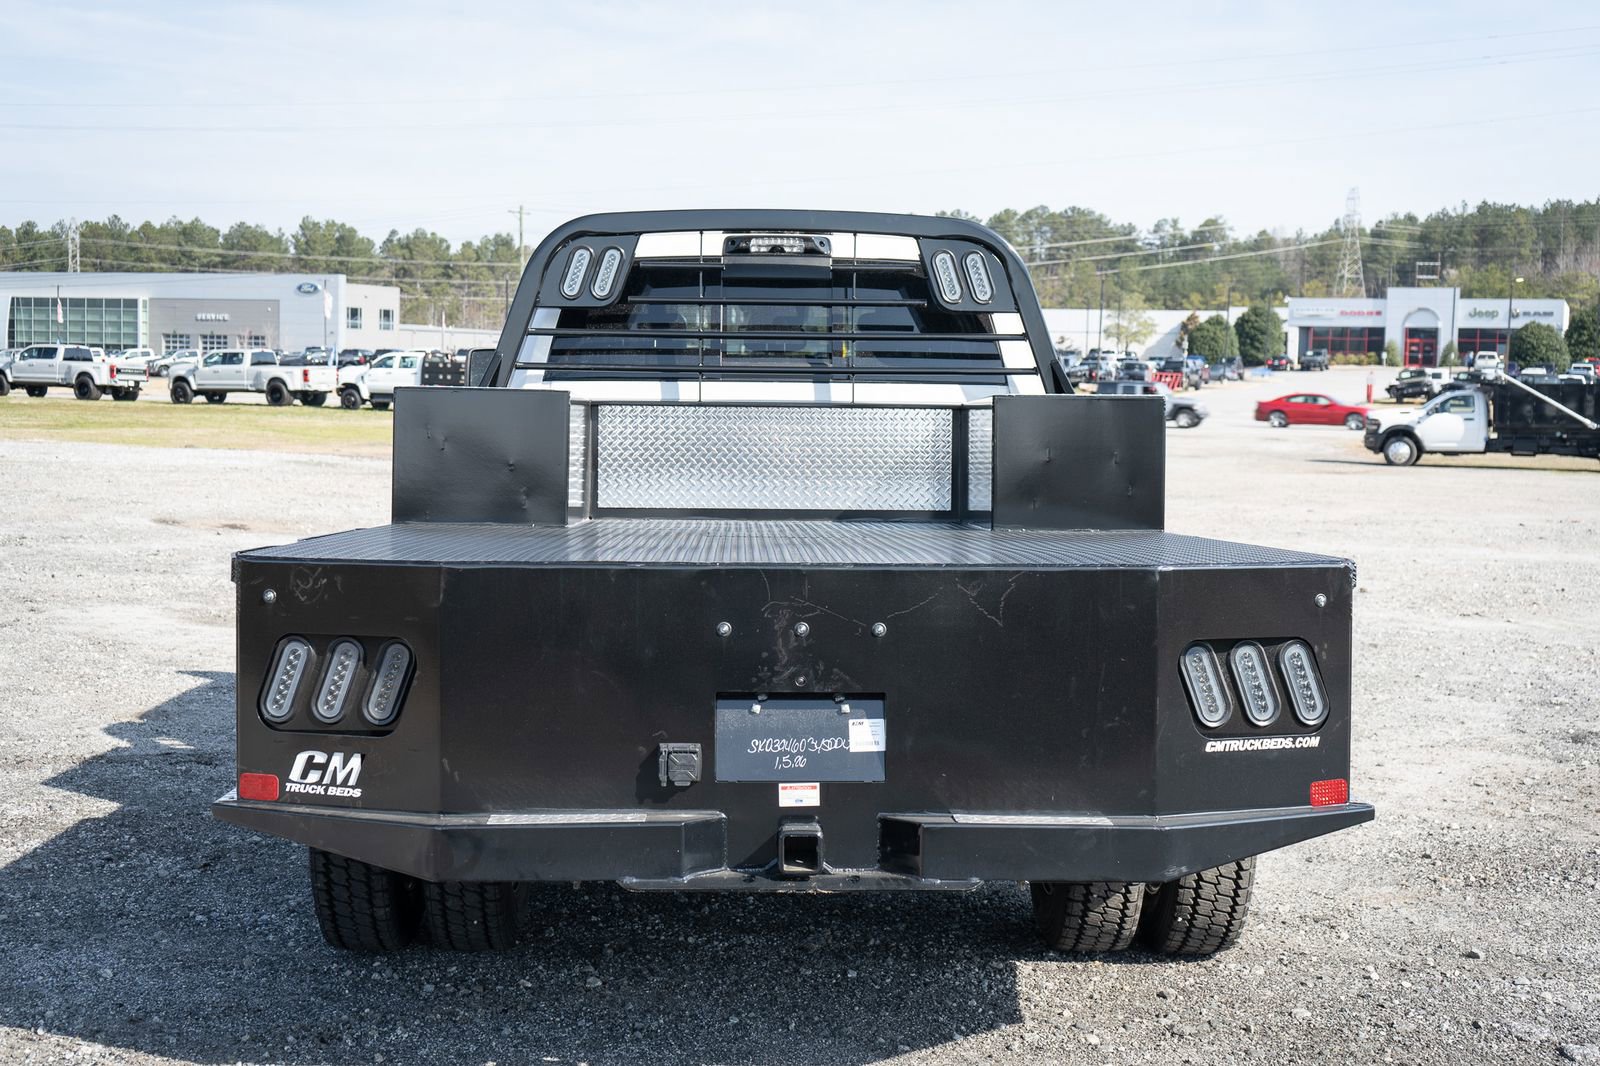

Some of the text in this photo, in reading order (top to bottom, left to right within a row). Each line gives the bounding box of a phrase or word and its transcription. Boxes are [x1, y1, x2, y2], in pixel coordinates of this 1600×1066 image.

[196, 313, 230, 321] SERVICE
[1468, 308, 1499, 319] Jeep
[1205, 736, 1320, 753] CMTRUCKBEDS.COM
[288, 750, 362, 786] CM
[285, 782, 362, 798] TRUCK BEDS
